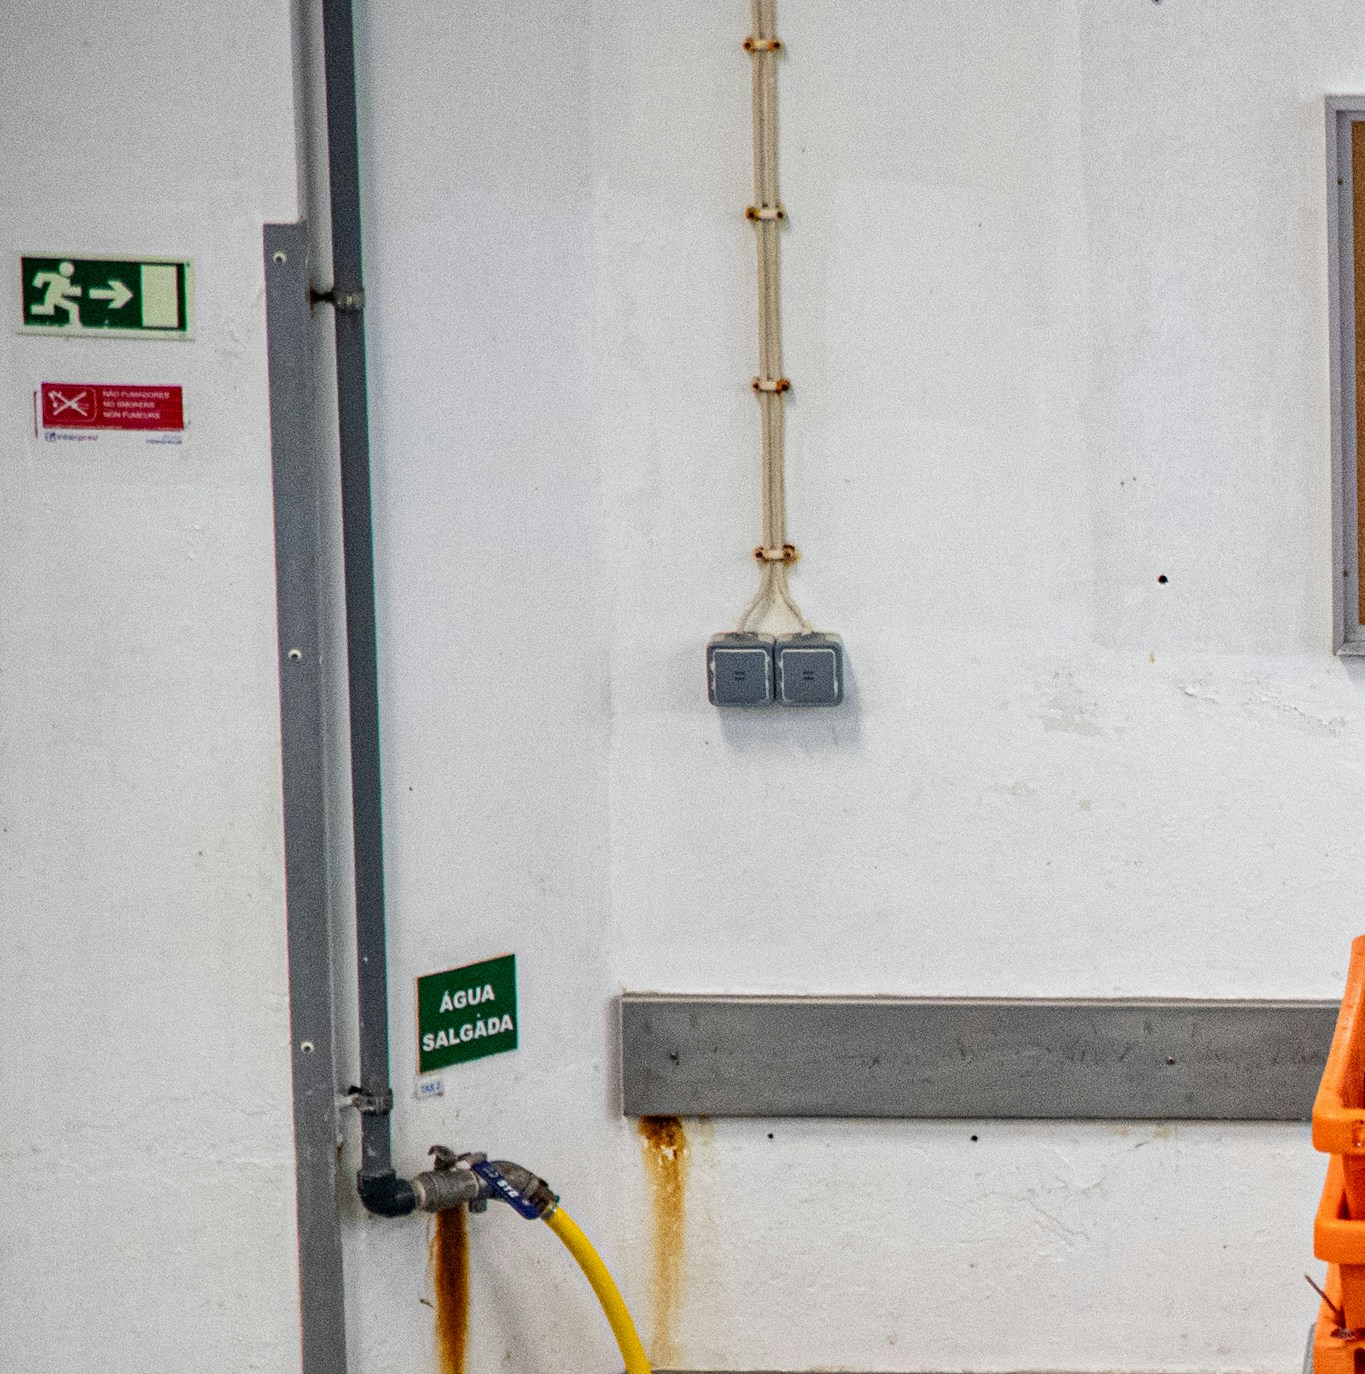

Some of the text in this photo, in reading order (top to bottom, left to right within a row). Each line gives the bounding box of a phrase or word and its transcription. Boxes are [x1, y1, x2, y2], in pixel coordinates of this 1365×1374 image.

[102, 390, 170, 399] NÃO FUMADORES
[116, 401, 155, 409] SMOKERS
[103, 411, 161, 419] NON FUMEURS
[439, 983, 496, 1014] ÁGUA
[422, 1014, 514, 1052] SALGADA
